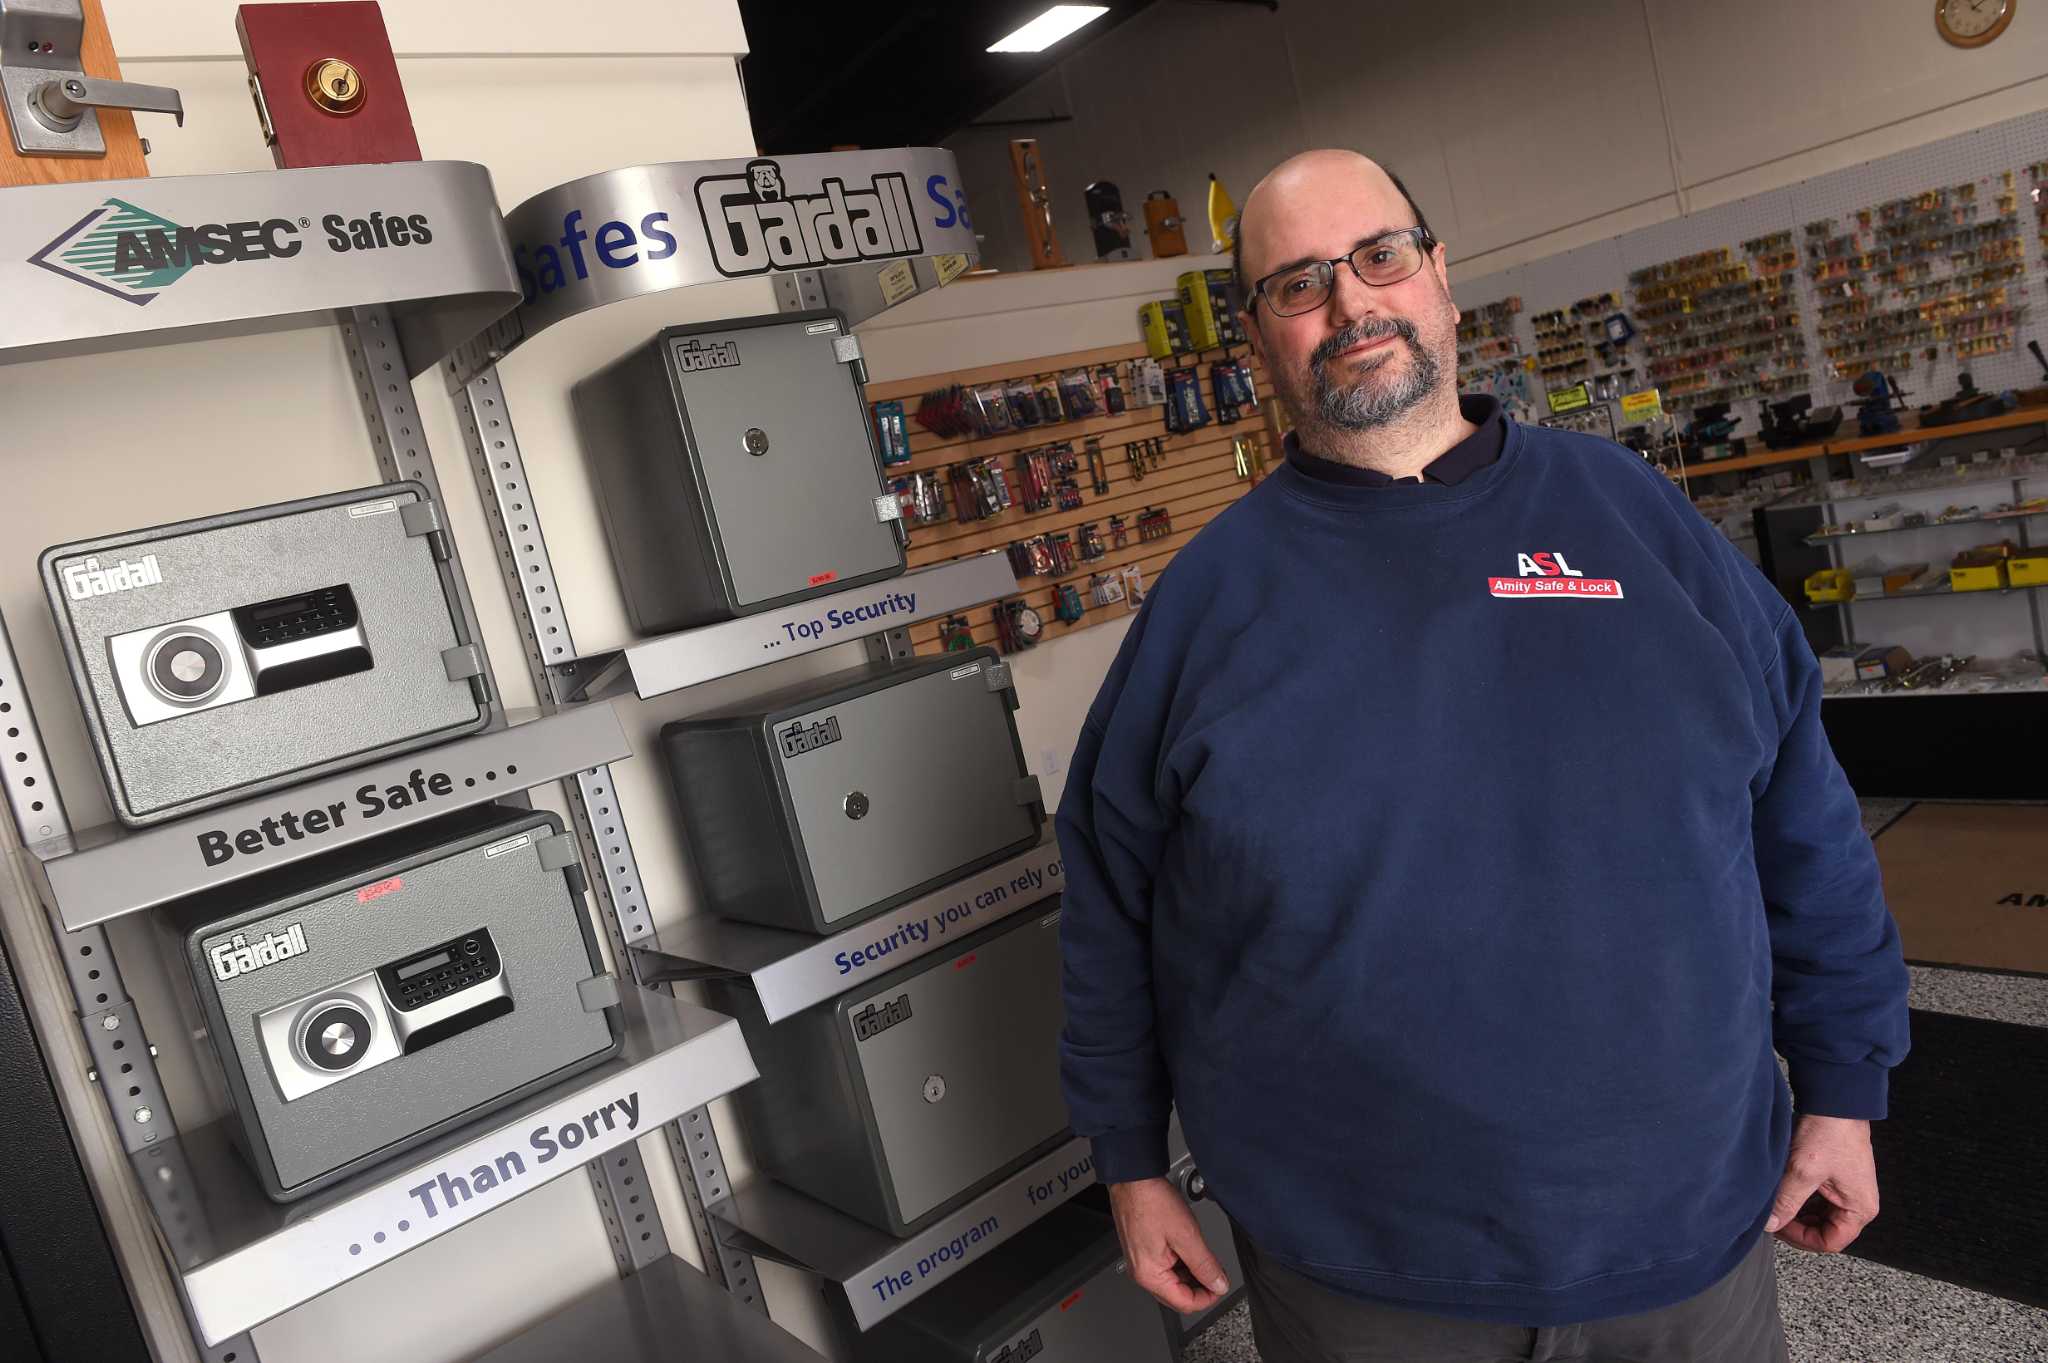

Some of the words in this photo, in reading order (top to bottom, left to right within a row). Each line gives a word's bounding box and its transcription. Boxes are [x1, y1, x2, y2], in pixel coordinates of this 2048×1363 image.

[322, 211, 433, 253] Safes
[694, 172, 924, 278] Gardall
[677, 340, 740, 372] Gardall
[63, 555, 163, 600] Gardall
[1493, 580, 1532, 592] Amity
[1535, 580, 1565, 591] Safe
[1568, 581, 1577, 591] &
[1581, 582, 1612, 593] Lock
[1517, 552, 1583, 577] ASL
[828, 591, 917, 629] Security
[779, 715, 842, 758] Gardall
[197, 798, 346, 867] Better
[834, 916, 930, 975] Security
[933, 900, 972, 934] you
[976, 886, 1007, 909] can
[1010, 868, 1042, 894] rely
[209, 922, 309, 982] Gardall
[853, 994, 913, 1042] Gardall
[529, 1091, 641, 1166] Sorry
[871, 1266, 913, 1303] The
[917, 1215, 999, 1278] program
[1026, 1180, 1054, 1206] for
